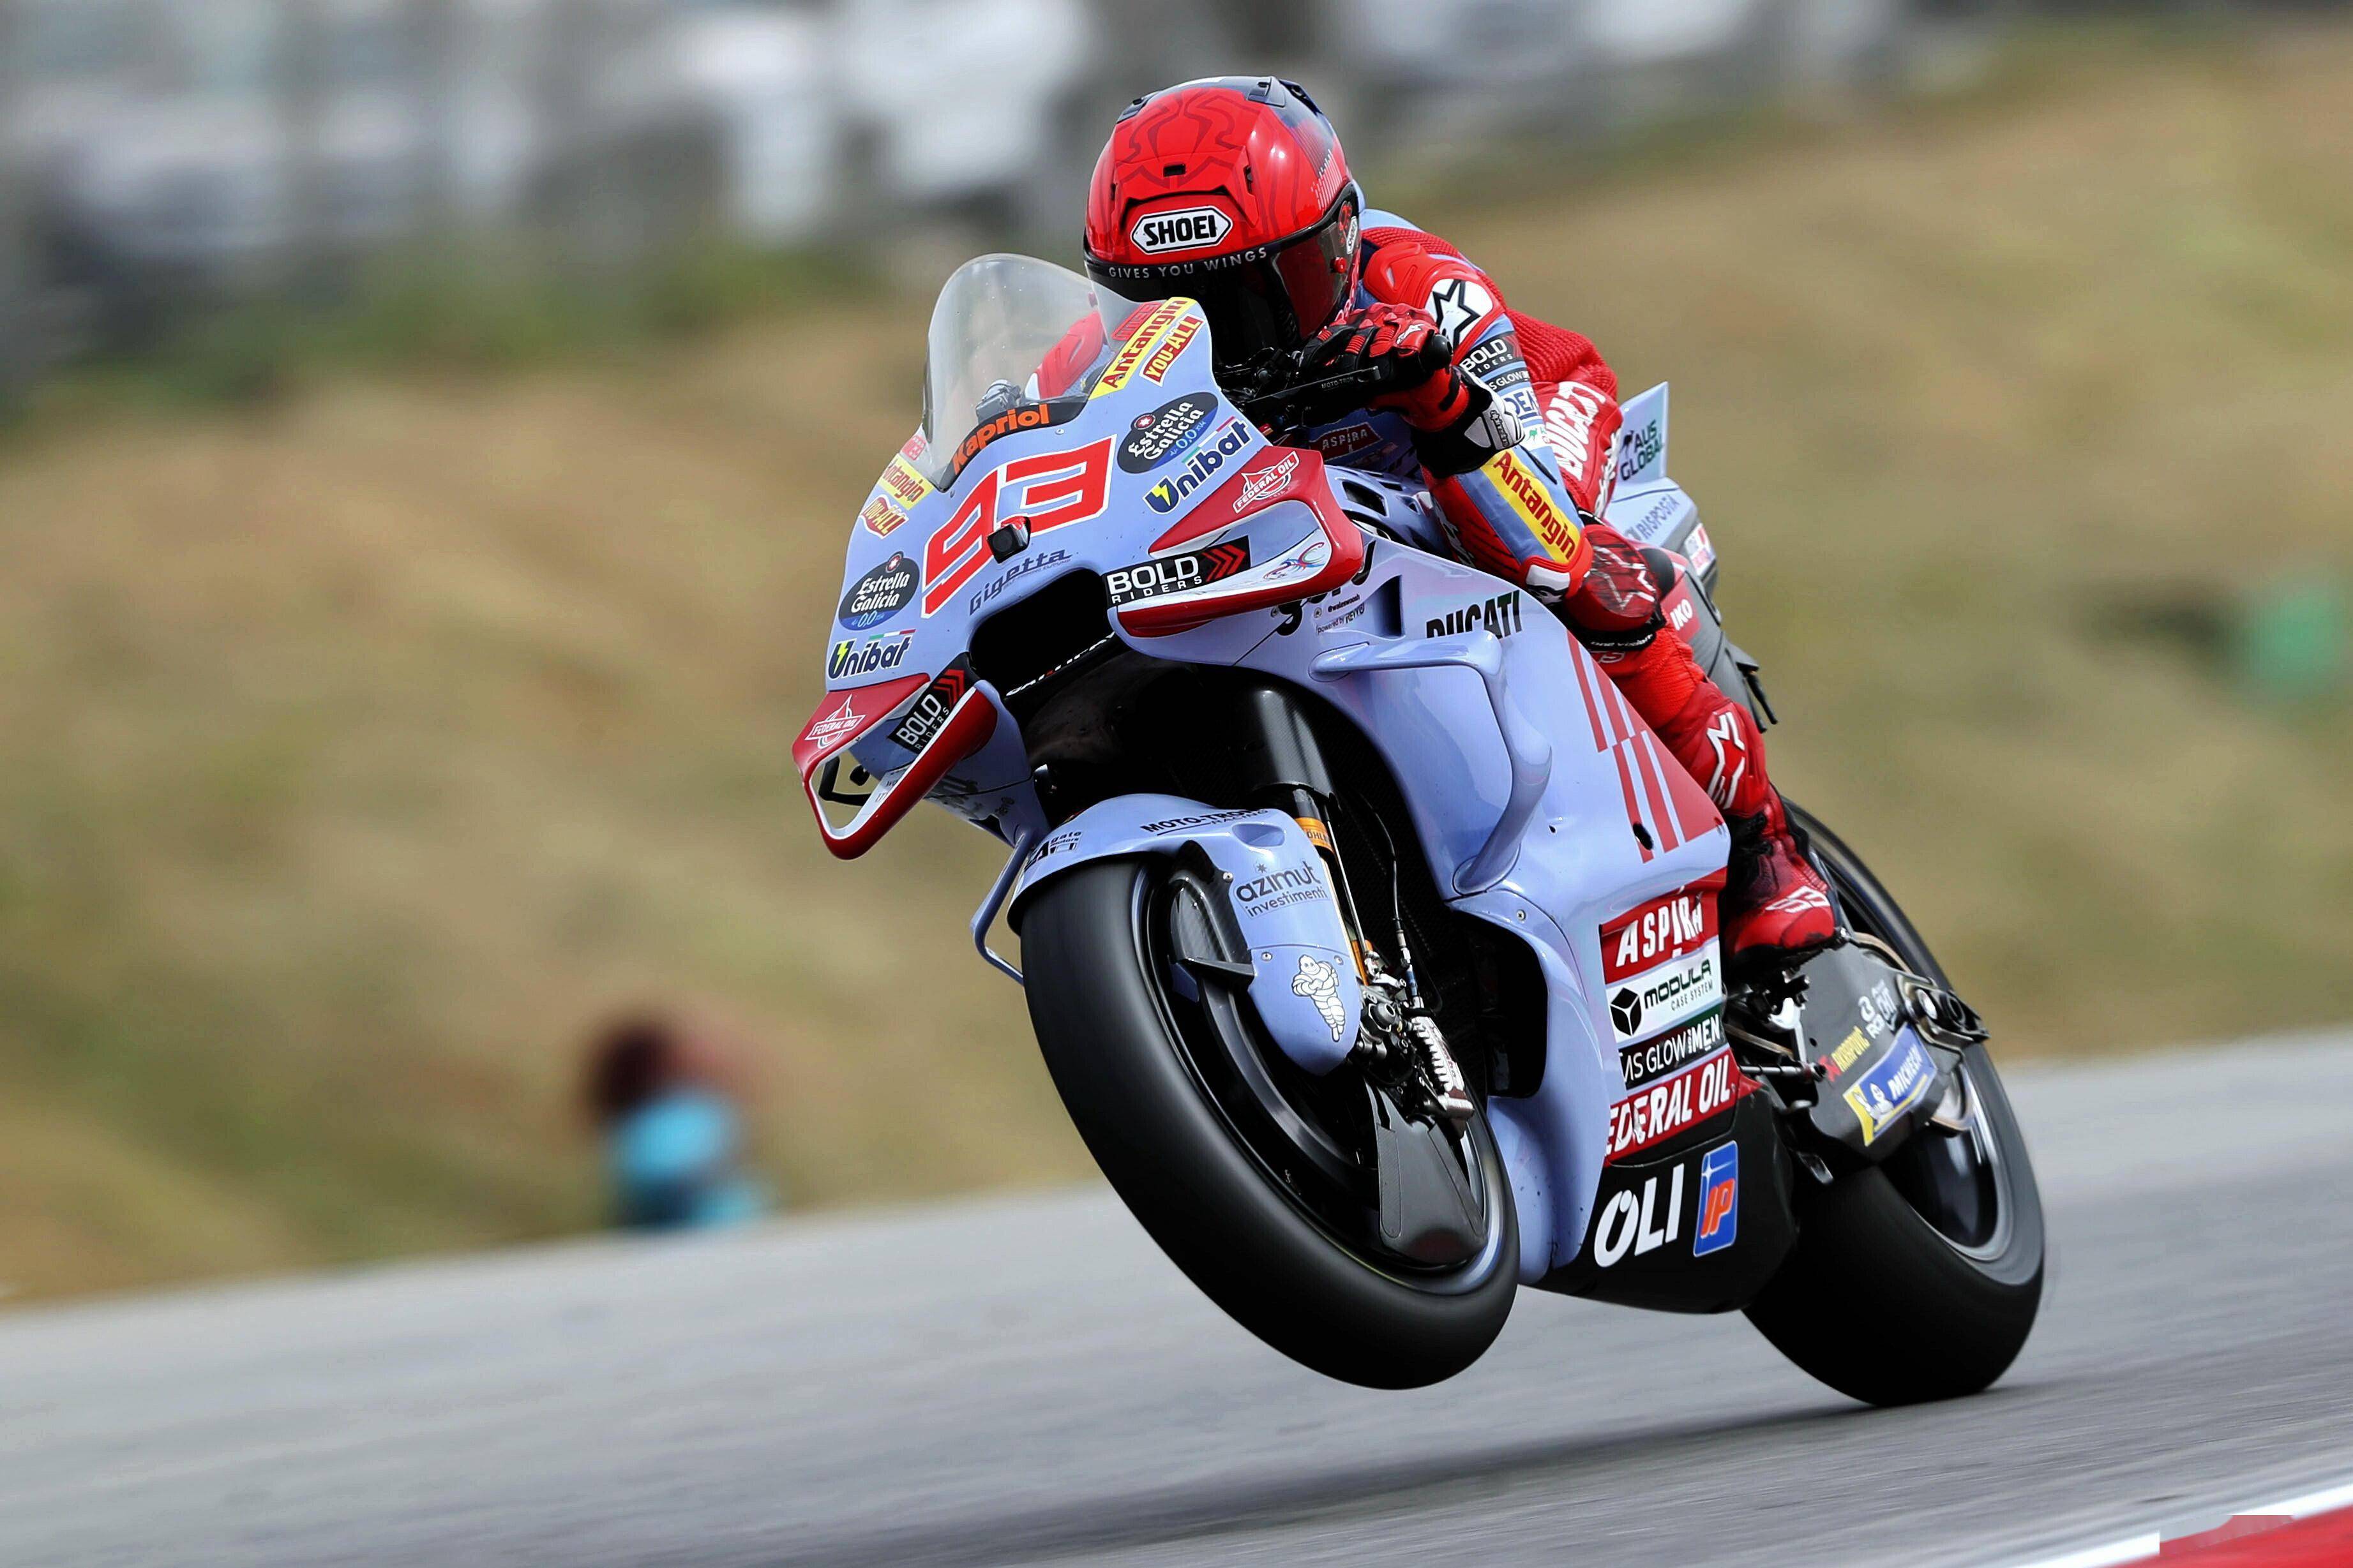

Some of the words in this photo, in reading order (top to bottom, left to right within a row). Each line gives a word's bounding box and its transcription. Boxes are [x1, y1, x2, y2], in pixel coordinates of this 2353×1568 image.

[1143, 215, 1217, 246] SHOEI
[1109, 267, 1150, 278] GIVES
[1158, 263, 1194, 277] YOU
[1204, 247, 1267, 271] WINGS
[1102, 300, 1188, 388] Antangin
[1145, 315, 1203, 379] YOU-ALL
[1459, 338, 1508, 371] BOLD
[1498, 371, 1522, 387] GLOW
[952, 404, 1049, 475] Kapriol
[1128, 401, 1194, 457] Estrella
[1143, 410, 1204, 459] Galicia
[1322, 429, 1368, 451] ASPIRA
[1634, 419, 1658, 452] AUS
[883, 459, 925, 503] ntangin
[1144, 420, 1251, 513] Unibat
[1237, 469, 1279, 507] FEDERAL
[1277, 456, 1295, 477] OIL
[921, 434, 1116, 618] 93
[1492, 450, 1576, 560] Antangin
[856, 571, 910, 595] Estrella
[969, 549, 1072, 616] Gigetta
[1107, 556, 1199, 595] BOLD
[1111, 576, 1203, 604] RIDERS
[851, 590, 900, 613] Galicia
[1426, 590, 1522, 639] DUCATI
[829, 636, 912, 679] Unibat
[813, 720, 844, 736] FEDERAL
[896, 694, 942, 746] BOLD
[915, 706, 950, 750] RIDERS
[1210, 809, 1268, 825] RACING
[1235, 860, 1321, 902] azimut
[1245, 886, 1328, 917] investimenti
[1615, 896, 1703, 967] ASPIRA
[1644, 959, 1711, 1010] MODULA
[1671, 996, 1688, 1011] CASE
[1690, 980, 1713, 1001] SYSTEM
[1646, 1030, 1686, 1073] GLOW
[1691, 1013, 1720, 1053] MEN
[1605, 1074, 1693, 1155] EDERAL
[1699, 1054, 1731, 1114] OIL
